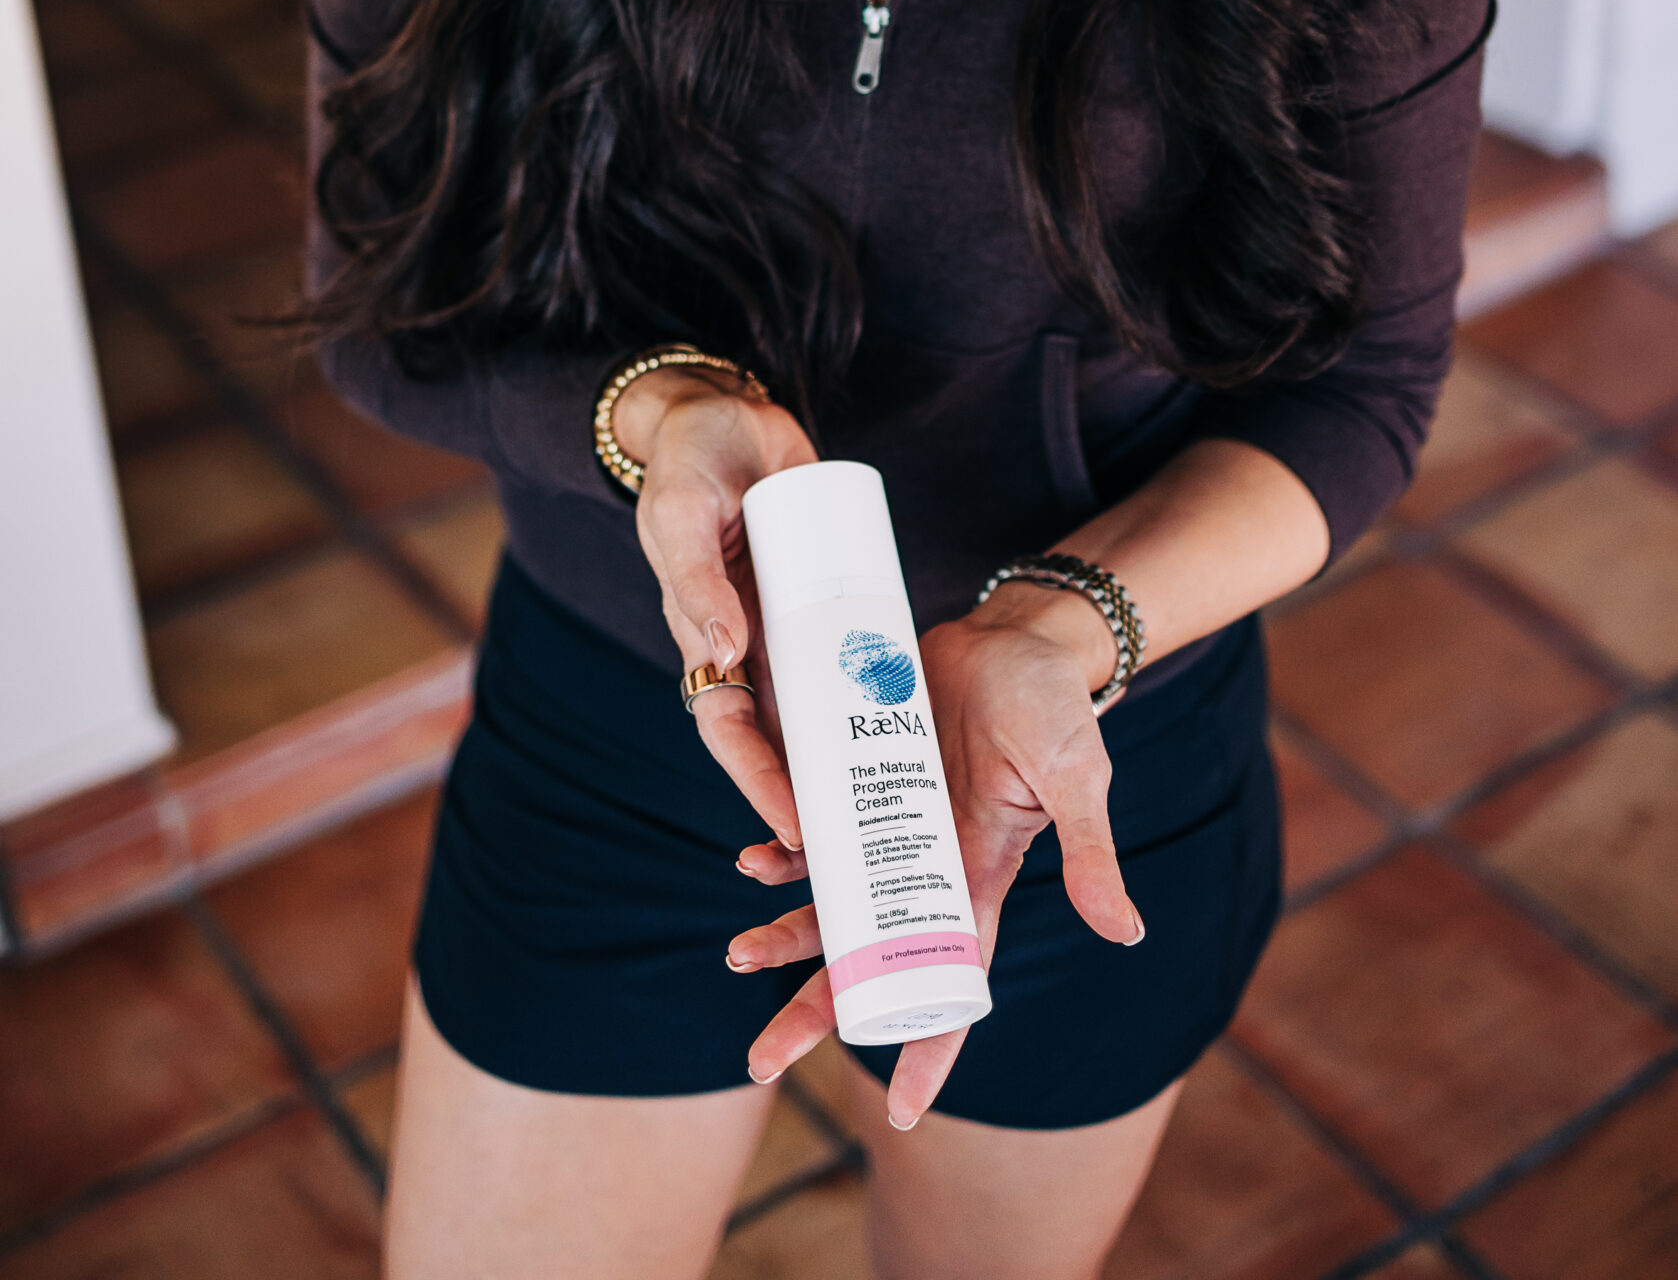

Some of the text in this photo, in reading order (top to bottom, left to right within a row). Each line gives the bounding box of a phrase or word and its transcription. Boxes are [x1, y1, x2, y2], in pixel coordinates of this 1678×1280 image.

[849, 760, 926, 780] The Natural
[853, 777, 937, 796] Progesterone
[856, 794, 903, 812] Cream
[858, 813, 900, 827] Bioidentical
[862, 838, 892, 849] Includes
[912, 833, 938, 841] Coconut
[864, 850, 874, 858] Oil
[882, 846, 900, 854] Shea
[902, 843, 922, 851] Butter
[865, 853, 920, 867] Fast Absorption
[876, 878, 900, 887] Pumps
[901, 874, 925, 883] Deliver
[926, 873, 944, 881] 50mg
[871, 891, 878, 899] of
[880, 884, 926, 896] Progesterone
[875, 907, 909, 921] 3oz (85g)
[877, 913, 961, 930] Approximately 280 Pumps
[882, 954, 893, 962] For
[895, 945, 938, 959] Professional
[952, 944, 965, 953] Only
